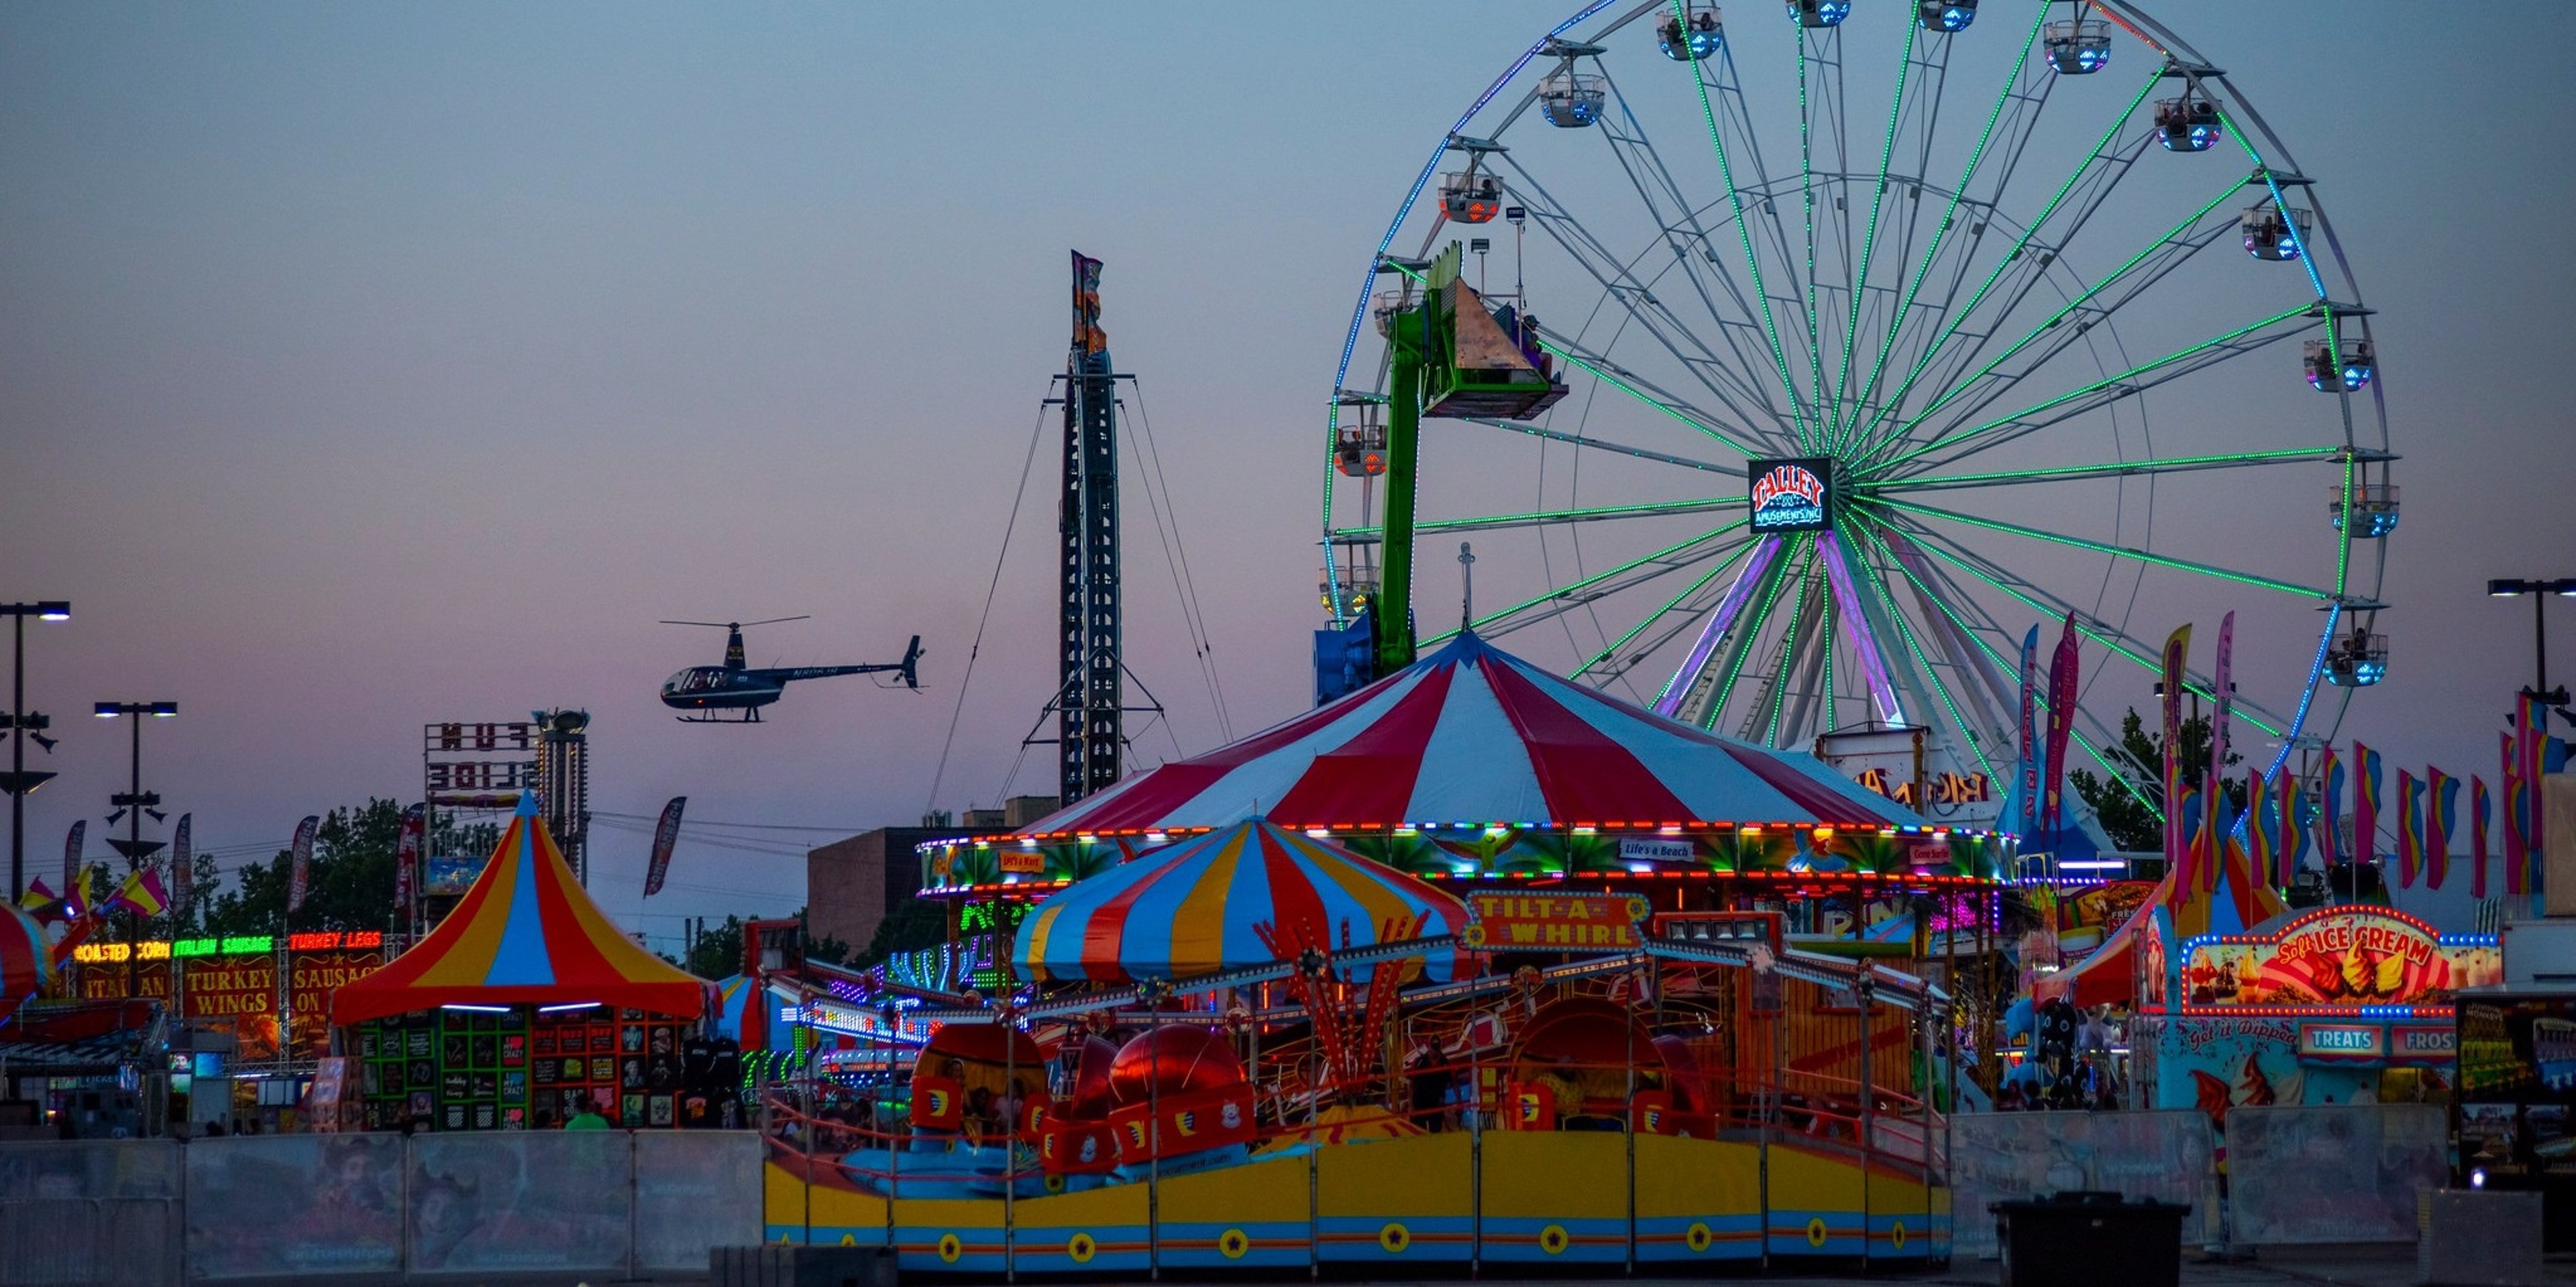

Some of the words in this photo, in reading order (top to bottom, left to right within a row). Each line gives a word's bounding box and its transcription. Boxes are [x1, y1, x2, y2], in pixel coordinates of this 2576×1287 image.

[1752, 464, 1825, 512] TALLEY
[1755, 510, 1805, 522] AMUSEMENTS
[1626, 844, 1650, 858] Life's
[1660, 846, 1688, 858] Beach
[1915, 849, 1931, 858] Gone
[289, 932, 342, 950] TURKEY
[346, 931, 383, 948] LEGS
[1511, 924, 1631, 945] WHIRL
[74, 943, 130, 962] ROASTED
[172, 938, 217, 956] ITALIAN
[222, 936, 273, 954] SAUSAGE
[2278, 936, 2314, 964] Soft
[2315, 928, 2349, 954] ICE
[2354, 926, 2432, 966] CREAM
[86, 976, 165, 998] ITALAN
[187, 968, 273, 991] TURKEY
[195, 993, 268, 1014] WINGS
[297, 993, 319, 1013] ON
[2466, 1009, 2504, 1022] MONKEYS
[2190, 1029, 2214, 1050] Get
[2217, 1022, 2232, 1038] it
[2237, 1020, 2298, 1044] Dipped
[2312, 1030, 2373, 1049] TREATS
